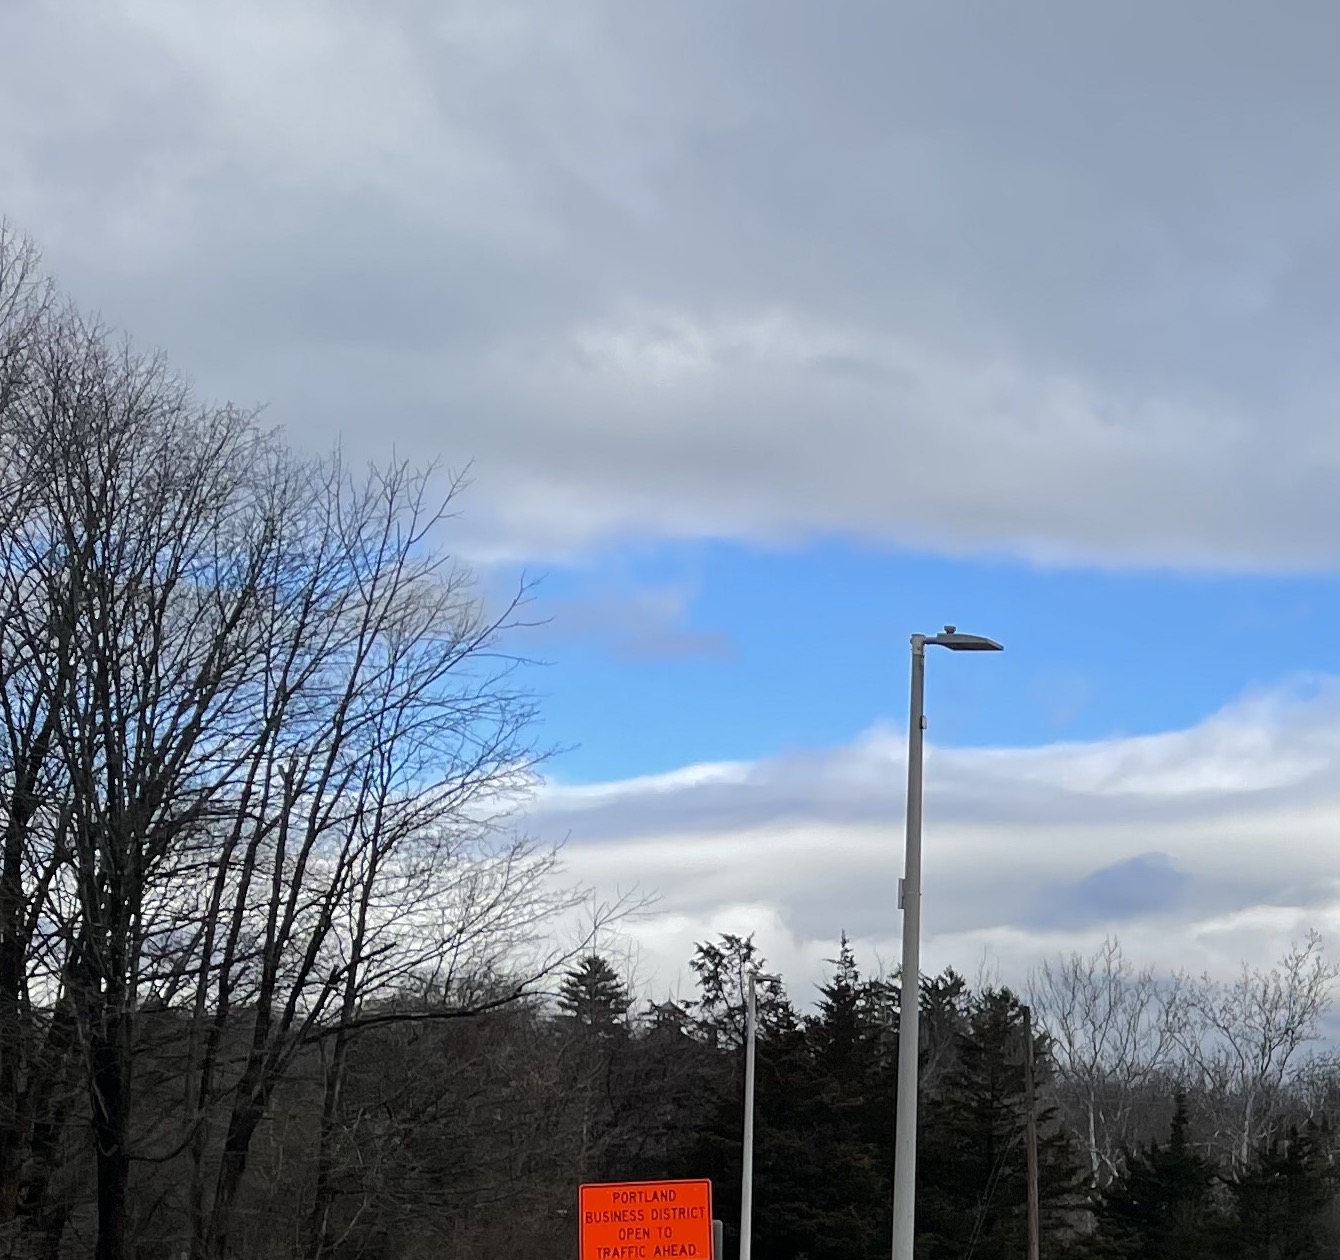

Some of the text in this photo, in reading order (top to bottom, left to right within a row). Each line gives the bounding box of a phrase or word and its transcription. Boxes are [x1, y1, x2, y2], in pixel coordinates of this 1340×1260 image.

[613, 1190, 676, 1204] PORTLAND
[585, 1206, 705, 1224] BUSINESS DISTRICT
[619, 1226, 672, 1240] OPEN TO
[597, 1243, 696, 1259] TRAFFIC AHEAD
